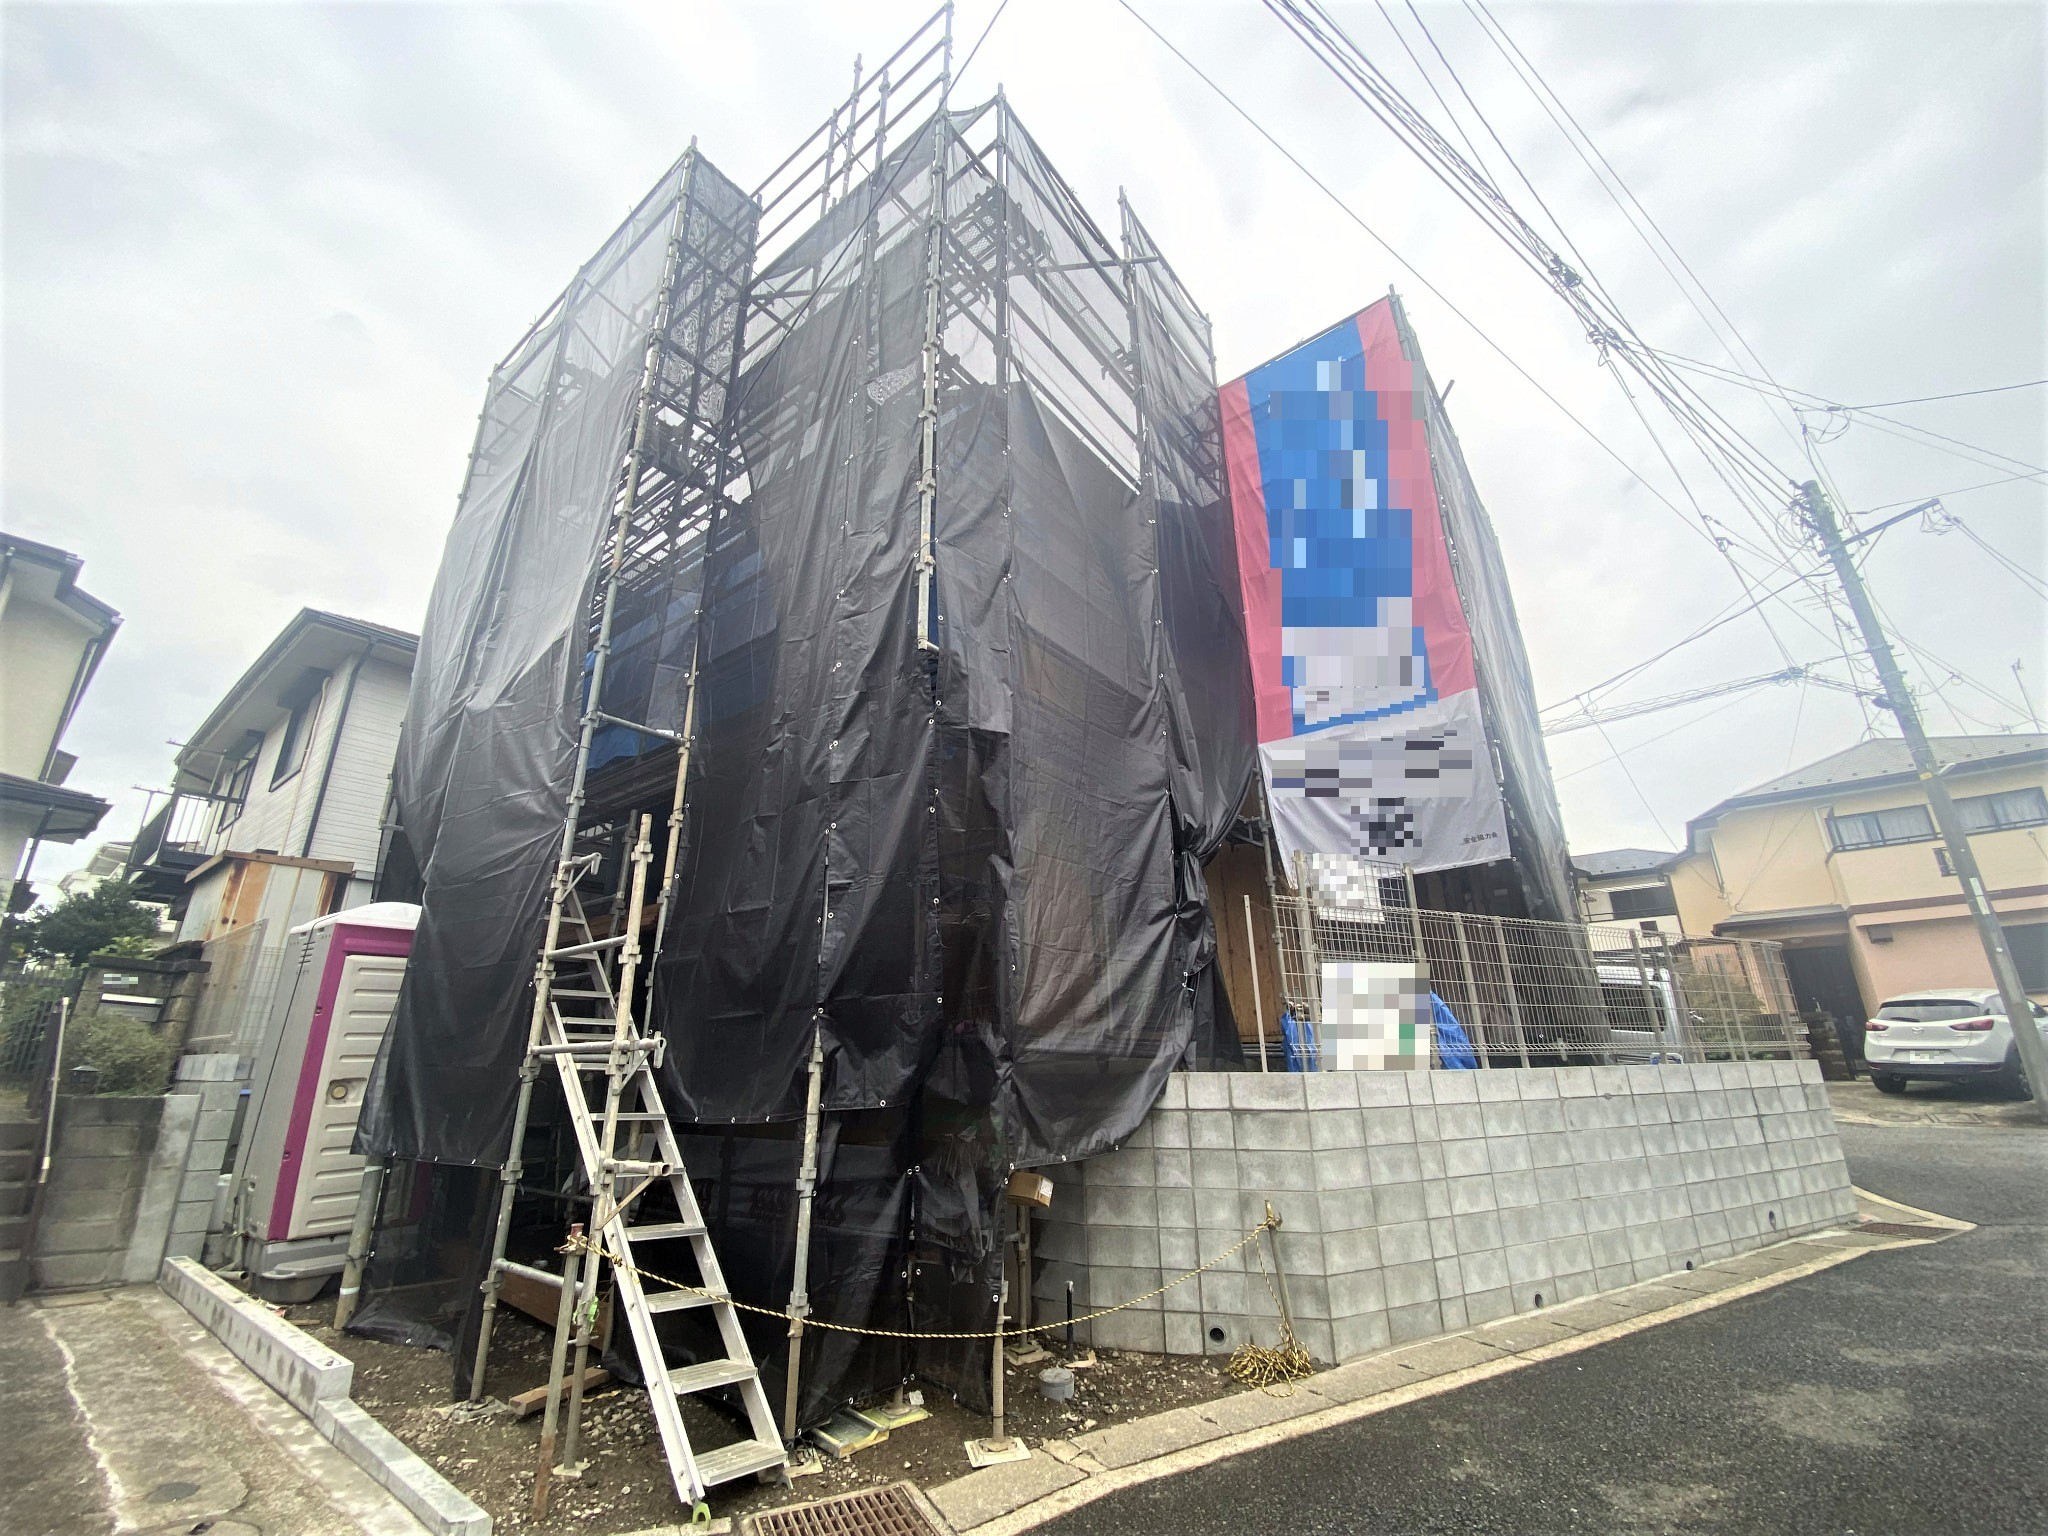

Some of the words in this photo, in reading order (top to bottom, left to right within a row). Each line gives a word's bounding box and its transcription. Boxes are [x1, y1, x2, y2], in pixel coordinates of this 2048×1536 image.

[1463, 831, 1498, 844] 安全協力会
